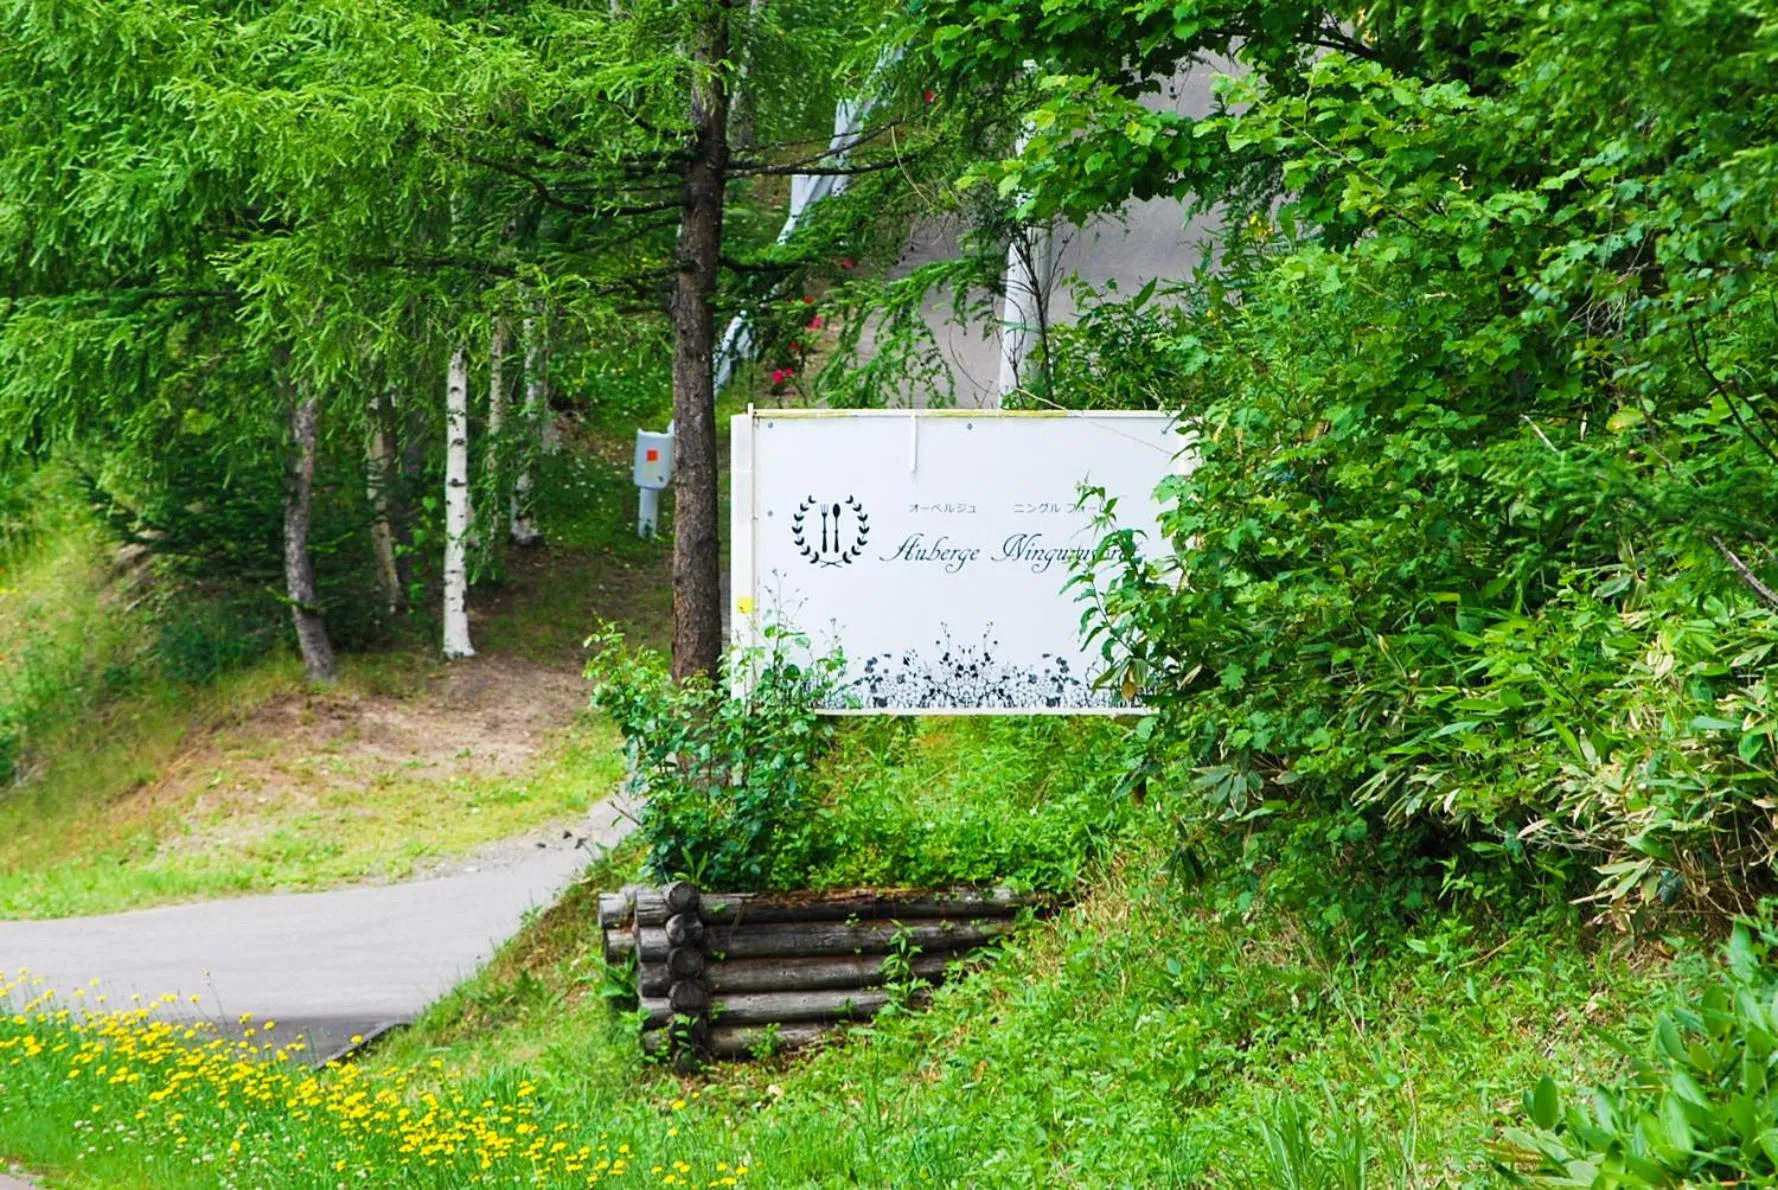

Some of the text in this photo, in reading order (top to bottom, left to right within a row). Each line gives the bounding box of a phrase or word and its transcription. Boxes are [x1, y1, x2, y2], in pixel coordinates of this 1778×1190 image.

[909, 503, 977, 514] オーベルジュ
[879, 533, 981, 574] Auberge
